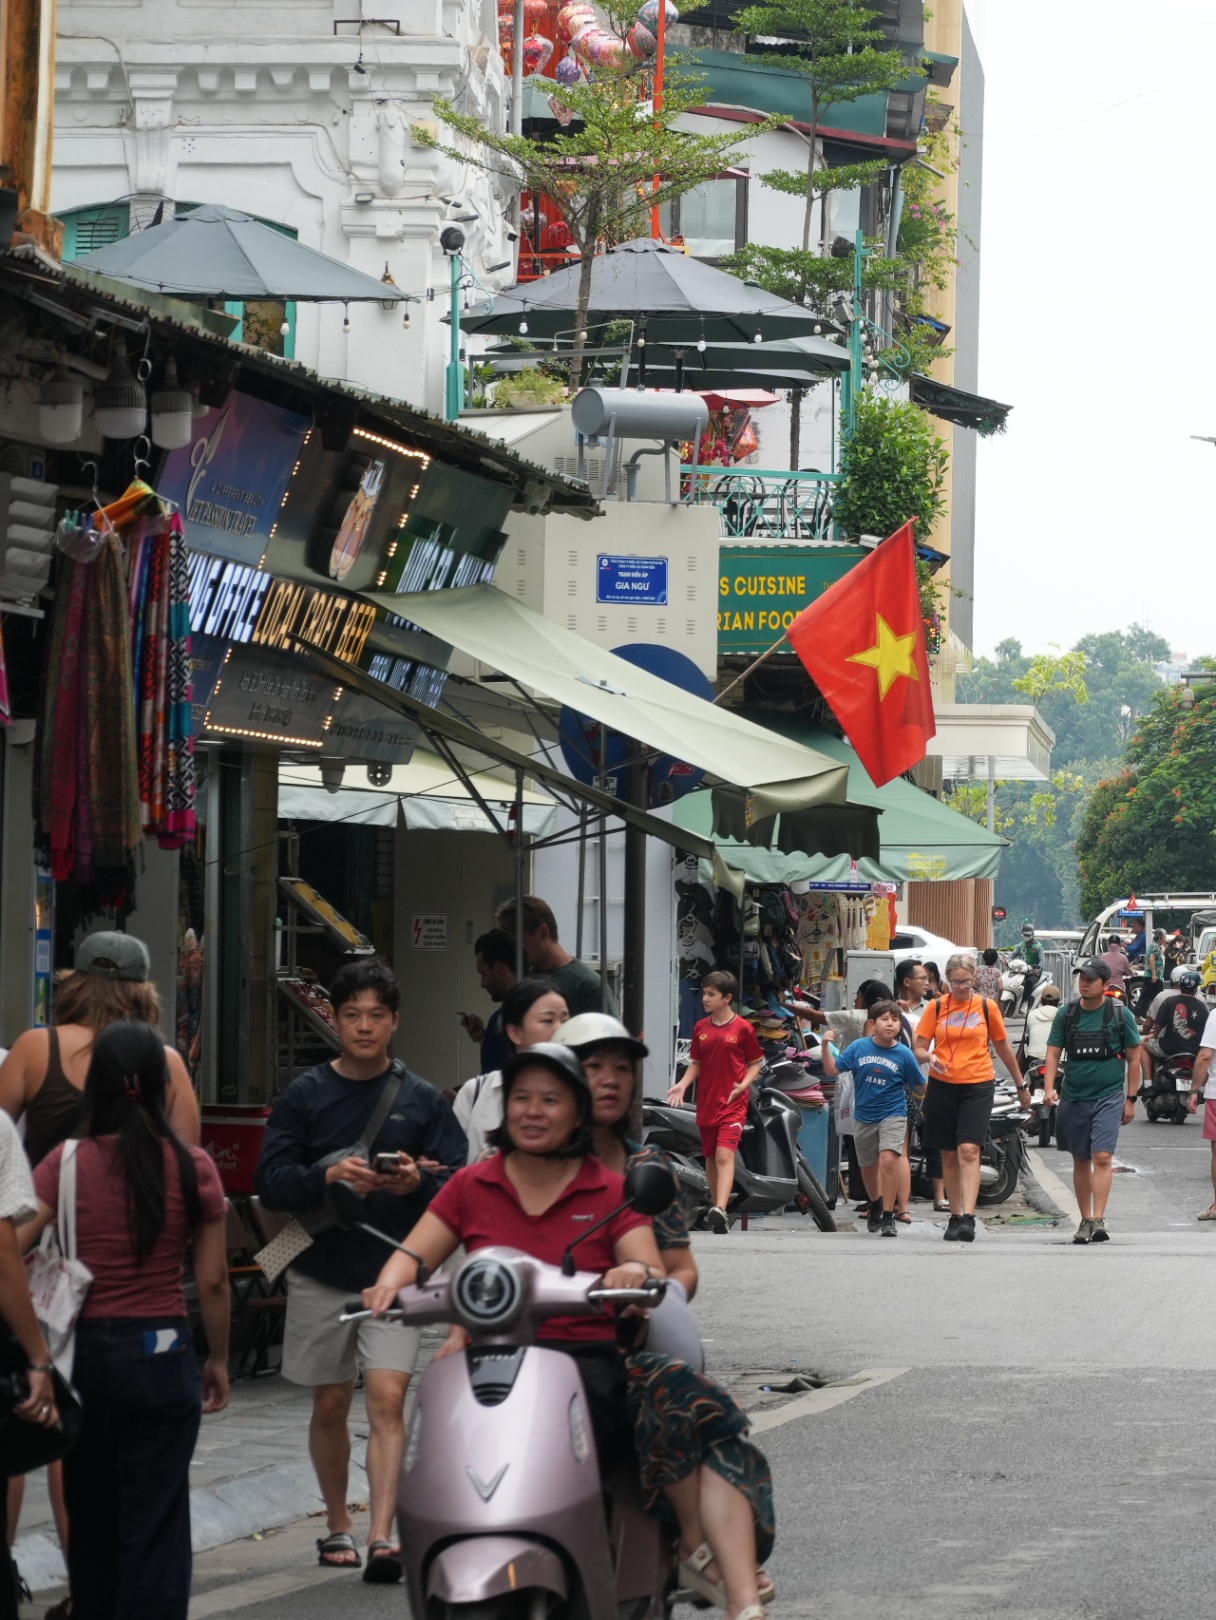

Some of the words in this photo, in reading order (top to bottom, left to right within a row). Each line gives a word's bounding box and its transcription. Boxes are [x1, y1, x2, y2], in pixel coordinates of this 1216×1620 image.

[186, 551, 225, 632] ING
[204, 562, 272, 643] OFFICE
[251, 579, 306, 650] LOCAL
[615, 581, 630, 590] GIA
[719, 576, 730, 596] S
[734, 576, 806, 596] CUISINE
[294, 590, 348, 654] CRAFT
[333, 601, 377, 665] BEER
[865, 1075, 887, 1086] JEANS
